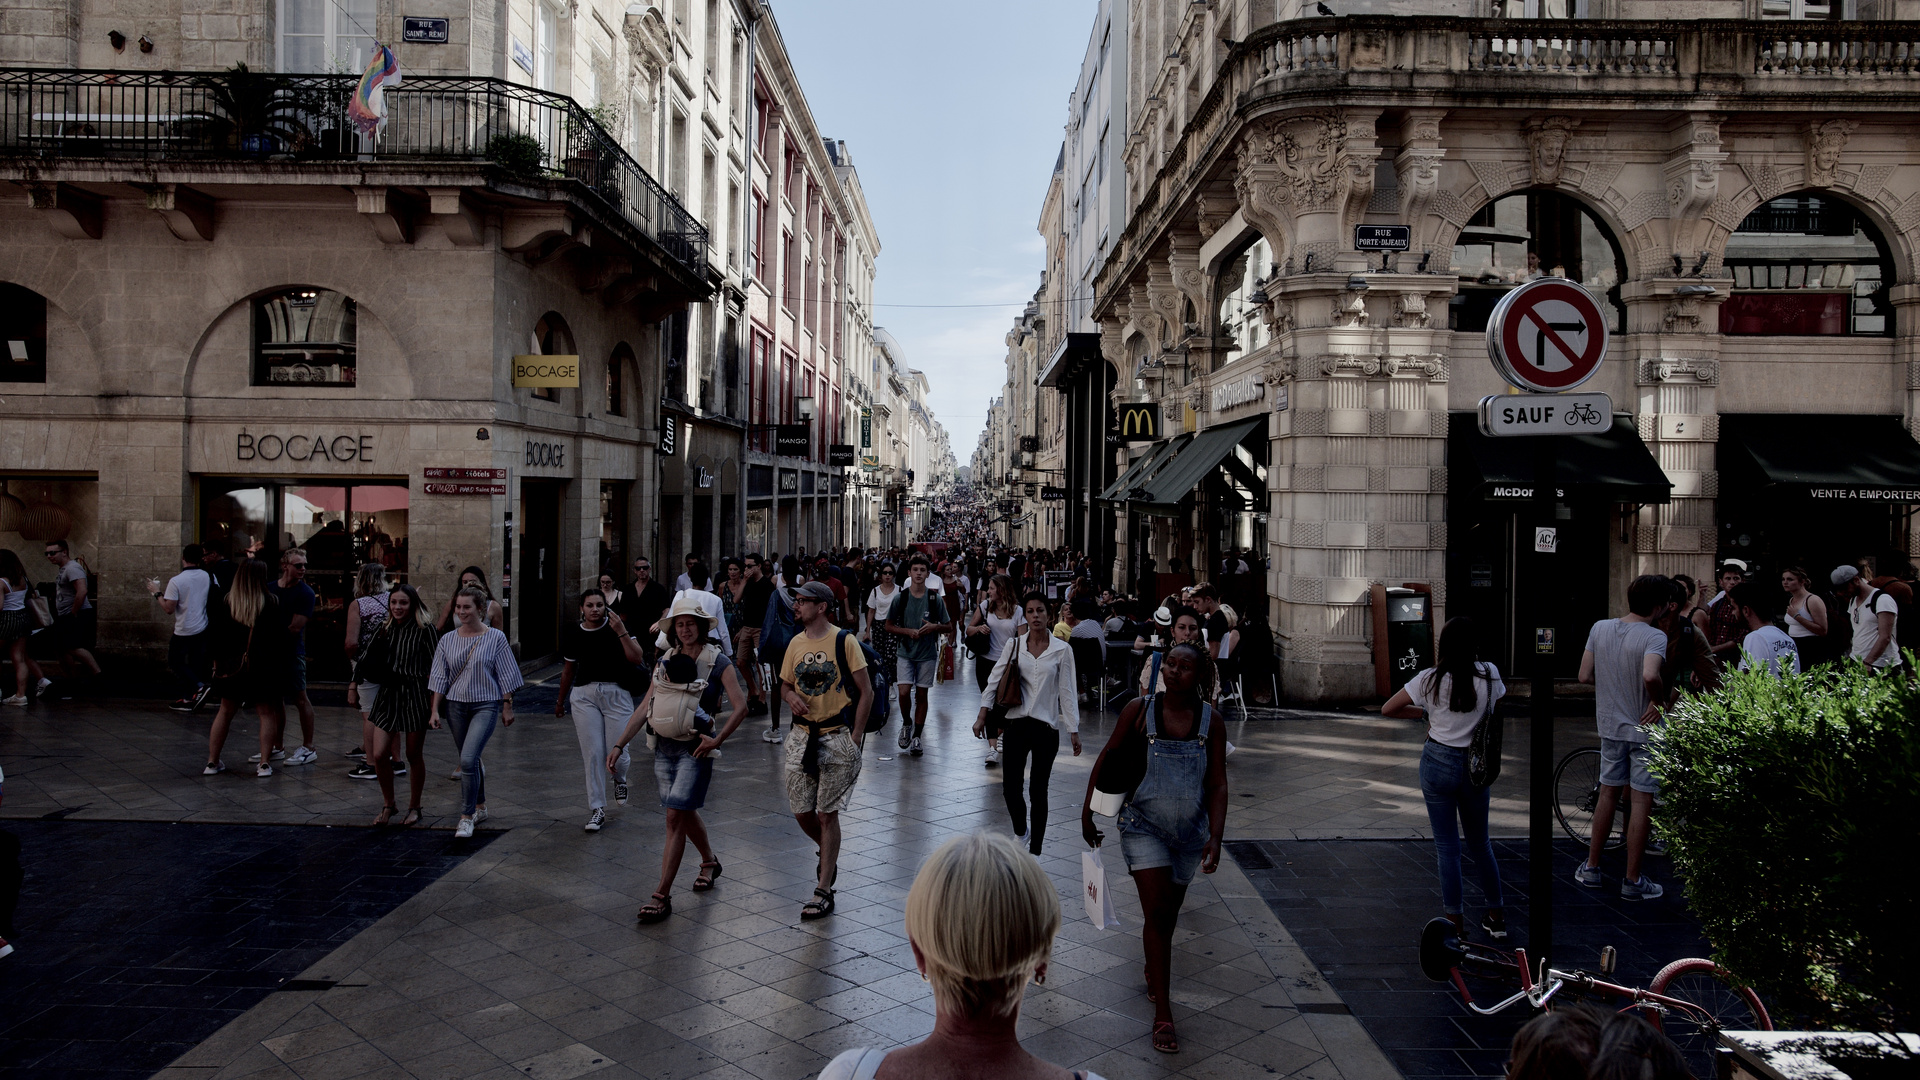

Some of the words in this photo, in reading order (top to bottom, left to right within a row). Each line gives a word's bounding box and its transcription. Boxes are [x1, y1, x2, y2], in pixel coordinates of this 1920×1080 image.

[517, 365, 575, 378] BOCAGE
[1503, 407, 1554, 424] SAUF
[662, 417, 674, 455] Etam
[237, 434, 373, 461] BOCAGE
[526, 441, 565, 467] BOCAGE
[1810, 489, 1847, 498] VENTE
[1848, 489, 1858, 499] A
[1859, 490, 1920, 500] EMPORTER
